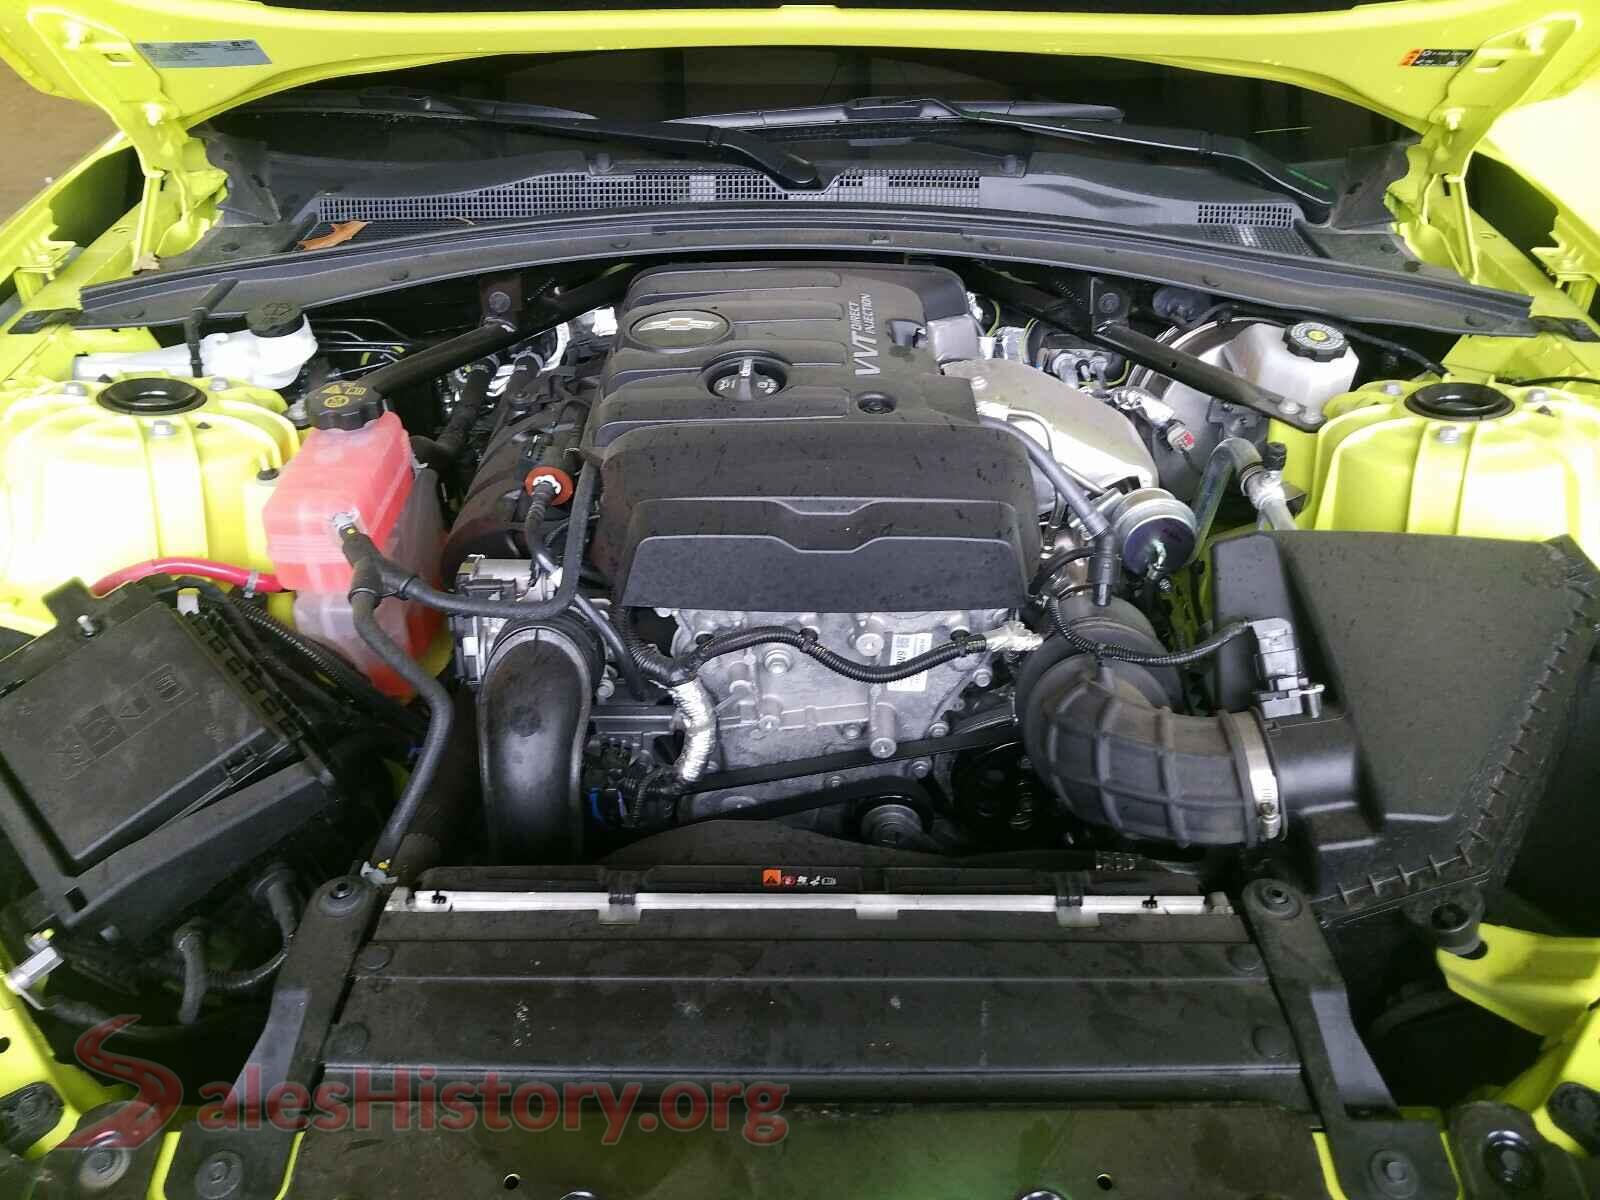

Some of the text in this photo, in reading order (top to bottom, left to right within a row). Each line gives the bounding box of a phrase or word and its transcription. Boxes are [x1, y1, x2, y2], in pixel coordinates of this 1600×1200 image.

[848, 301, 862, 331] DIRECT
[860, 292, 876, 335] INJECTION
[851, 330, 881, 375] VVT
